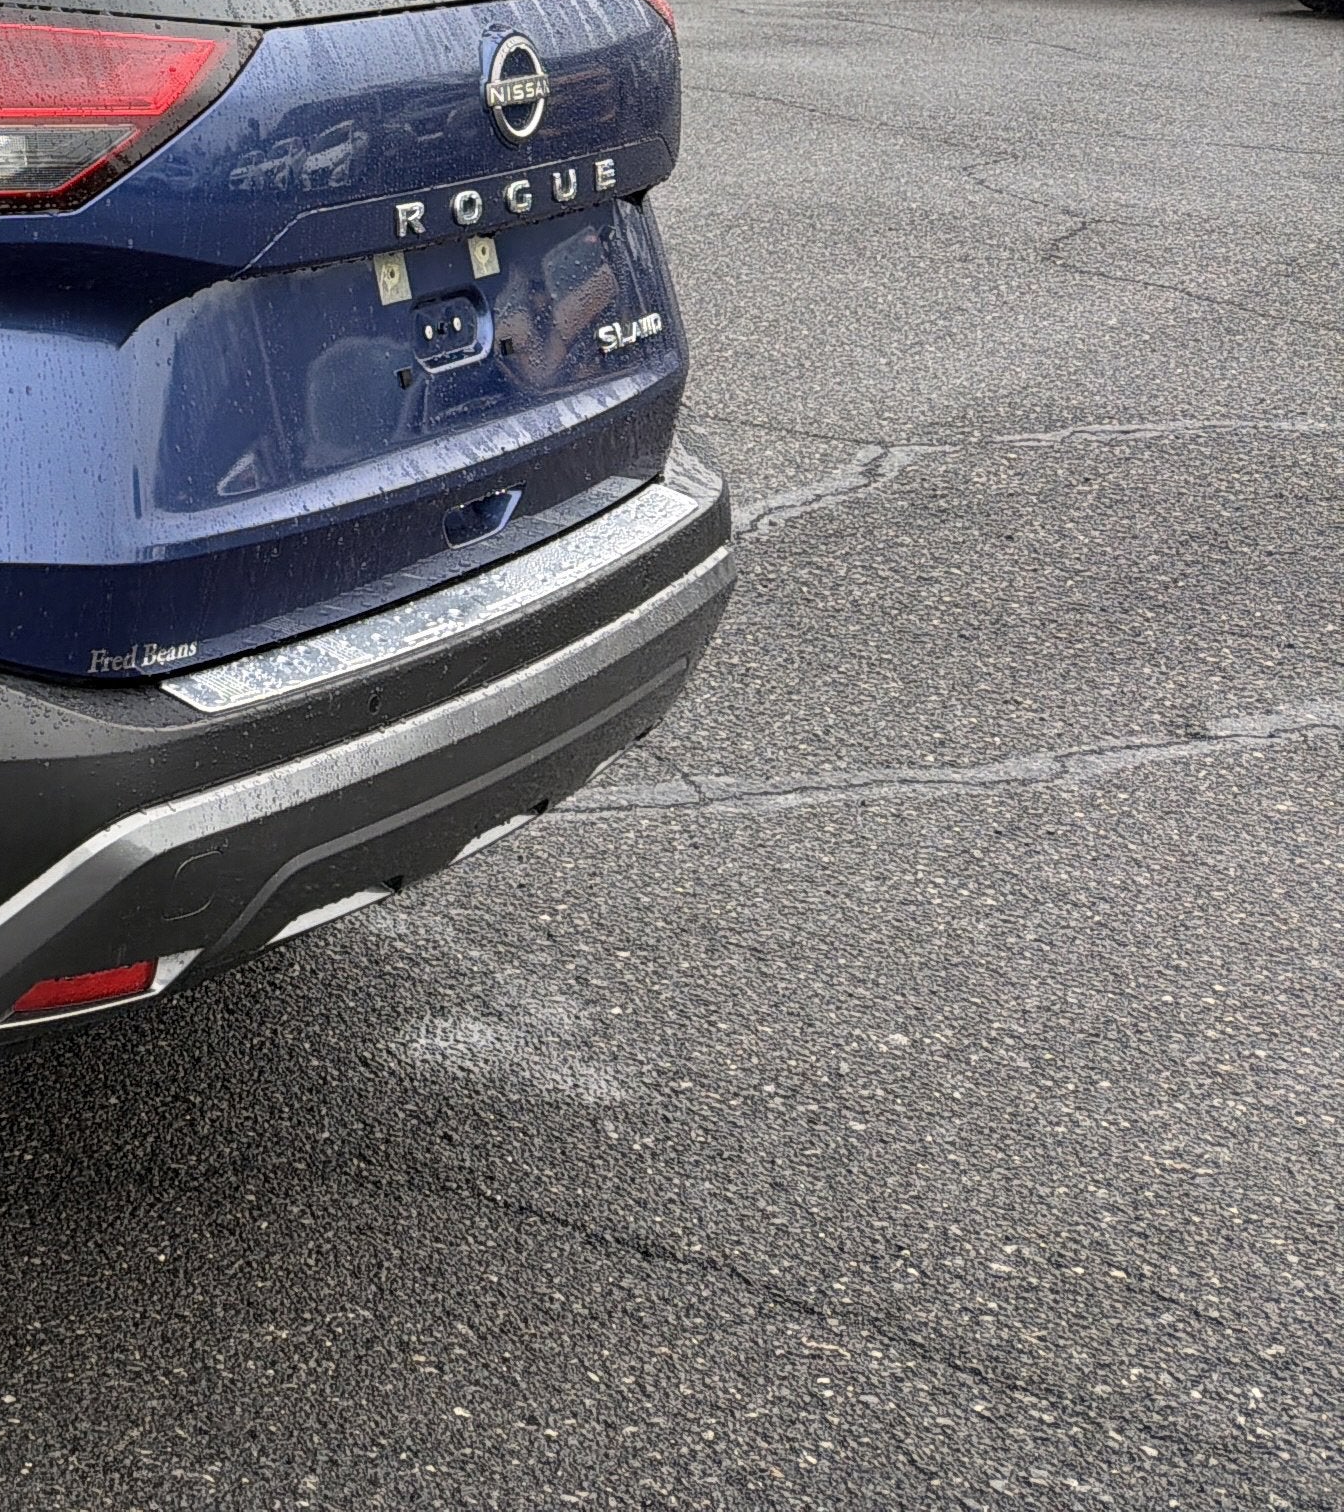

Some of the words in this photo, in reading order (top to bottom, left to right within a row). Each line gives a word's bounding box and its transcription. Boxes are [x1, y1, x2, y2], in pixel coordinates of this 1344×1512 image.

[490, 79, 550, 104] NISSAN
[396, 159, 616, 237] ROGUE
[87, 643, 138, 674] Fred
[141, 641, 198, 666] Beans
